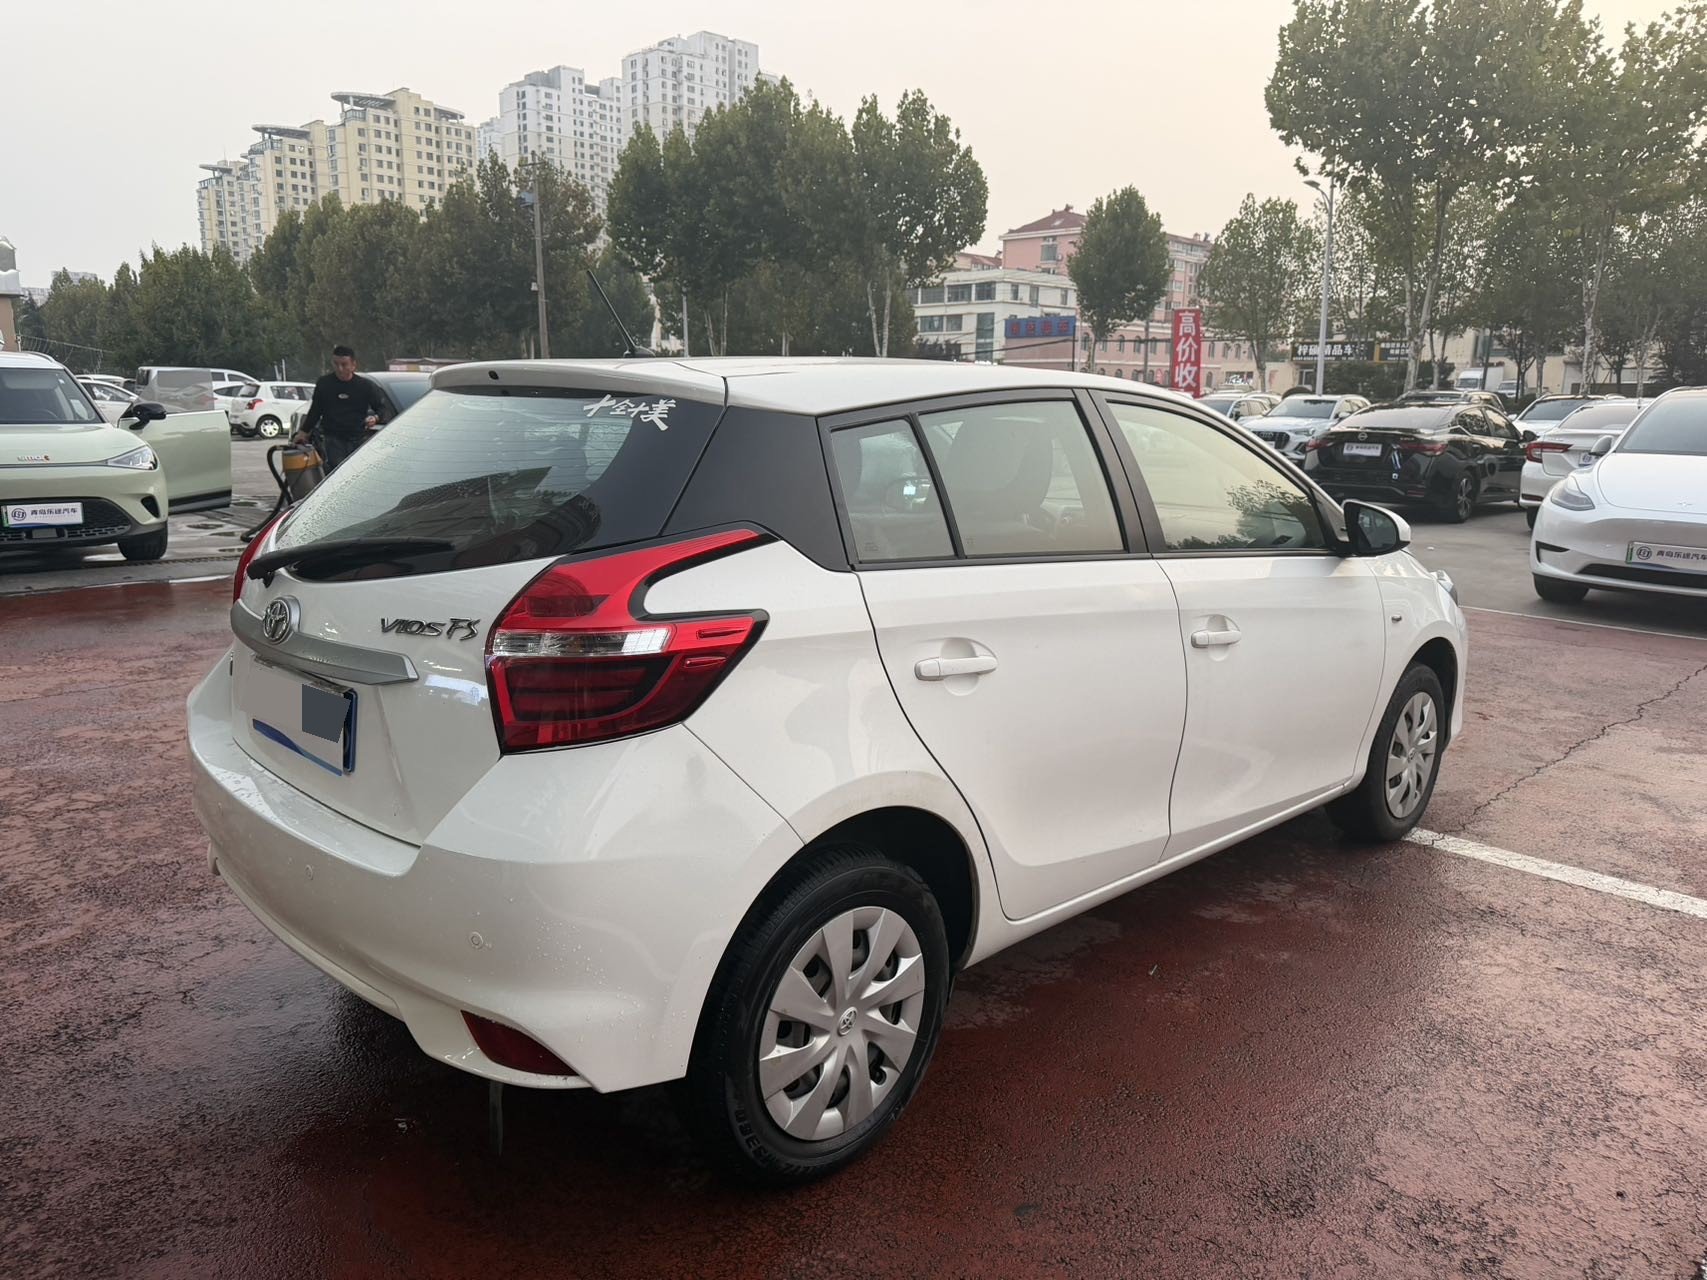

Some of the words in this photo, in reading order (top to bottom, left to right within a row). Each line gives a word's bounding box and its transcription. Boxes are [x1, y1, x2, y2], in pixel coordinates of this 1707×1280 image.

[1174, 310, 1199, 390] 高价收
[583, 393, 677, 431] 十全十美
[380, 618, 447, 636] VIOS
[446, 617, 481, 641] FS
